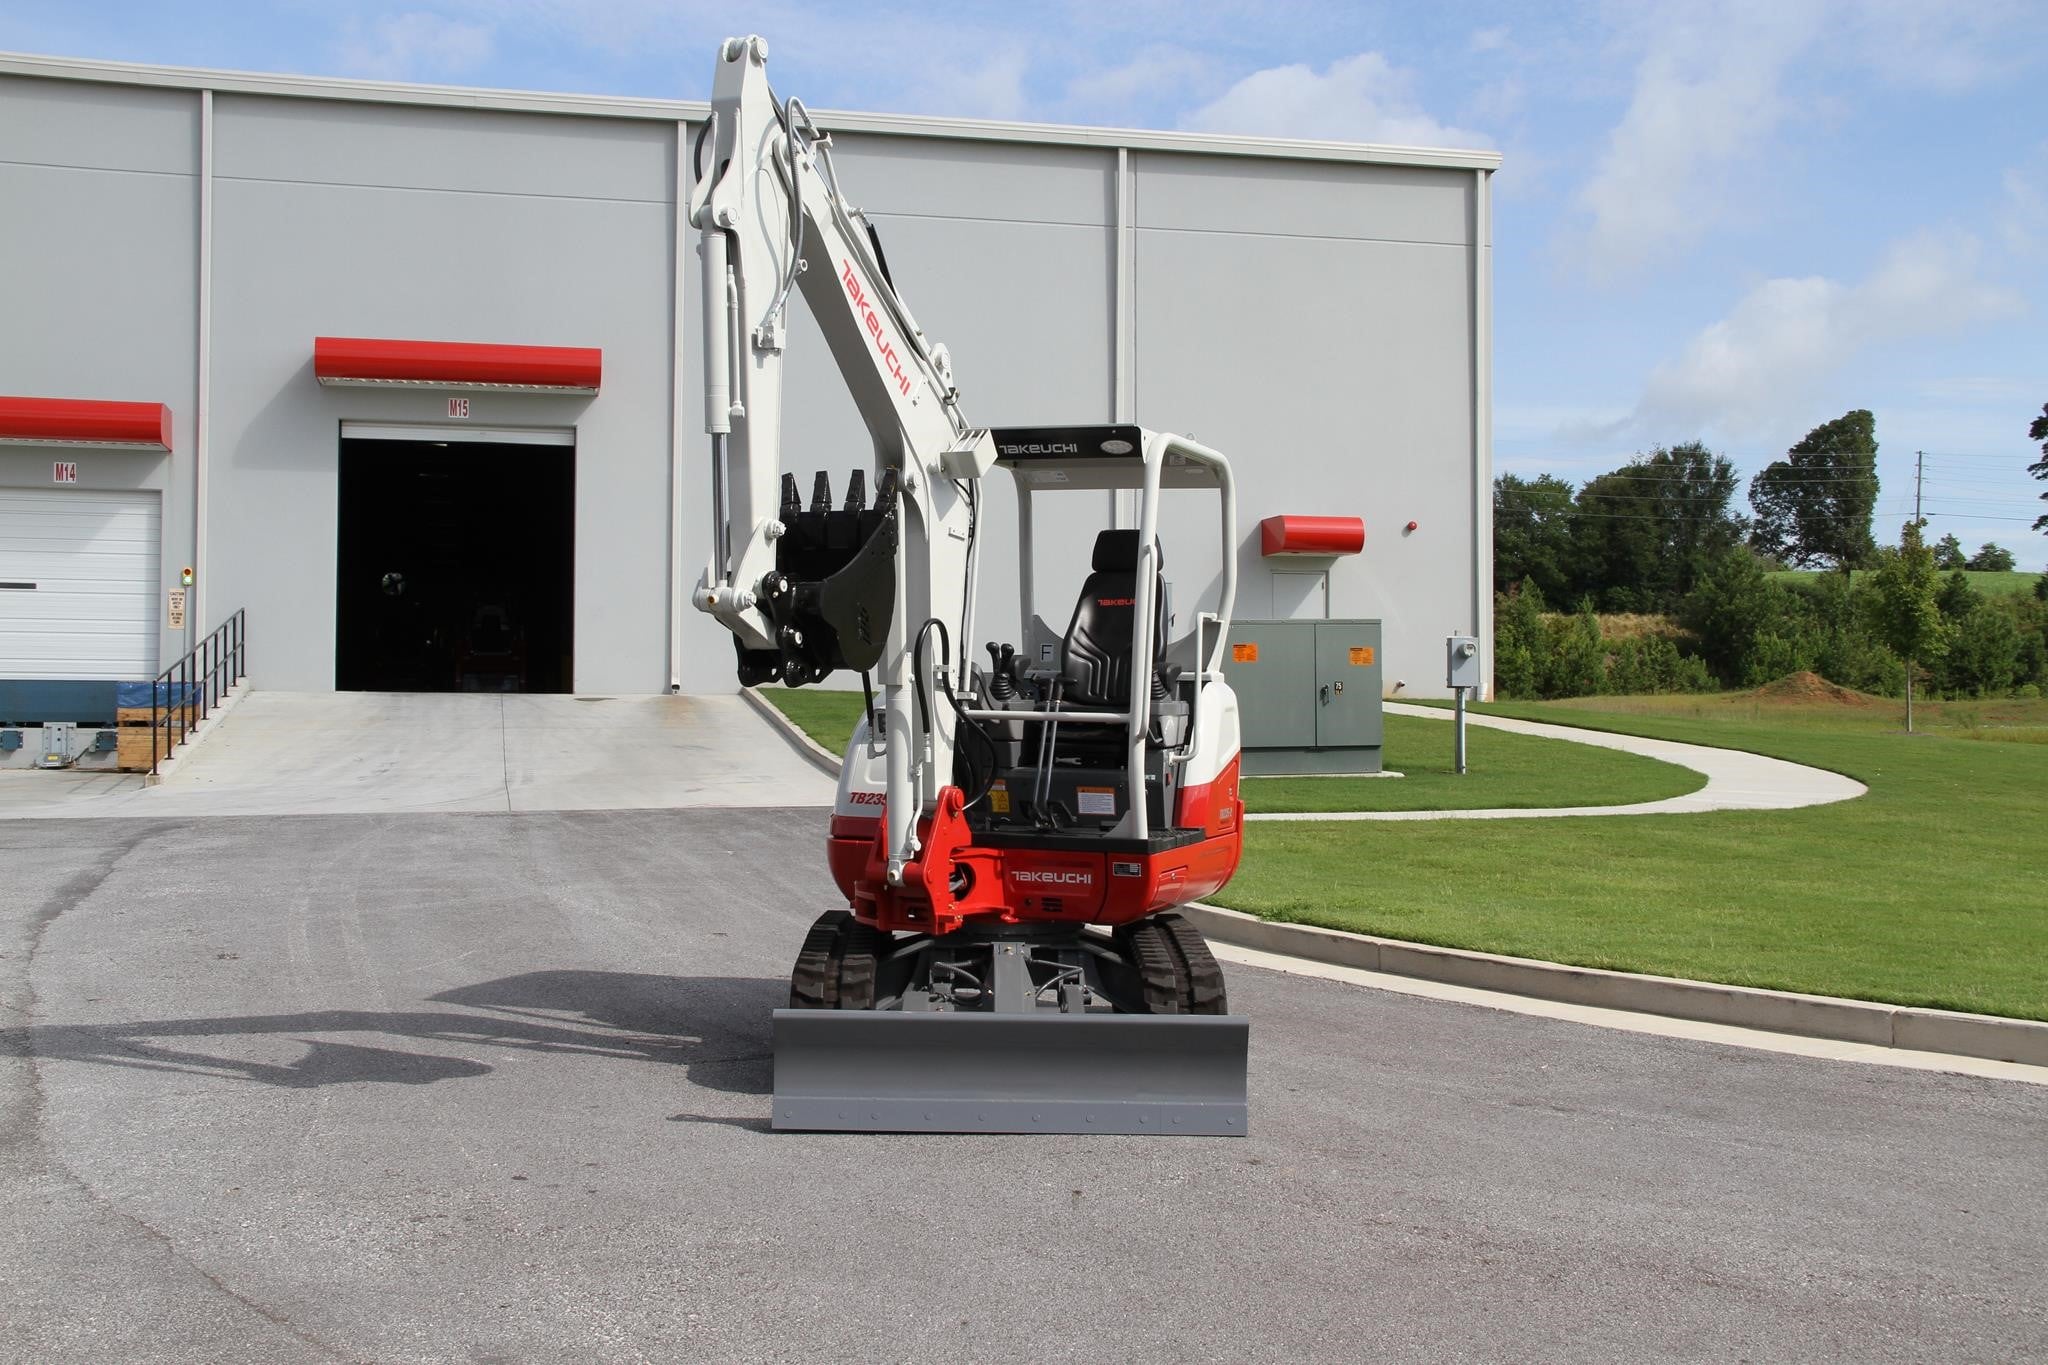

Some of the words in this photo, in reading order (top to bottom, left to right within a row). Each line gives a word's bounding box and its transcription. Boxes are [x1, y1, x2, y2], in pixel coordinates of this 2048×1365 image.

[842, 258, 911, 397] TAKEUCHI
[450, 399, 468, 417] M15
[999, 443, 1078, 454] TAKEUCHI
[55, 462, 76, 482] M14
[1097, 598, 1137, 606] TAKEU
[1011, 871, 1091, 884] TAKEUCHI
